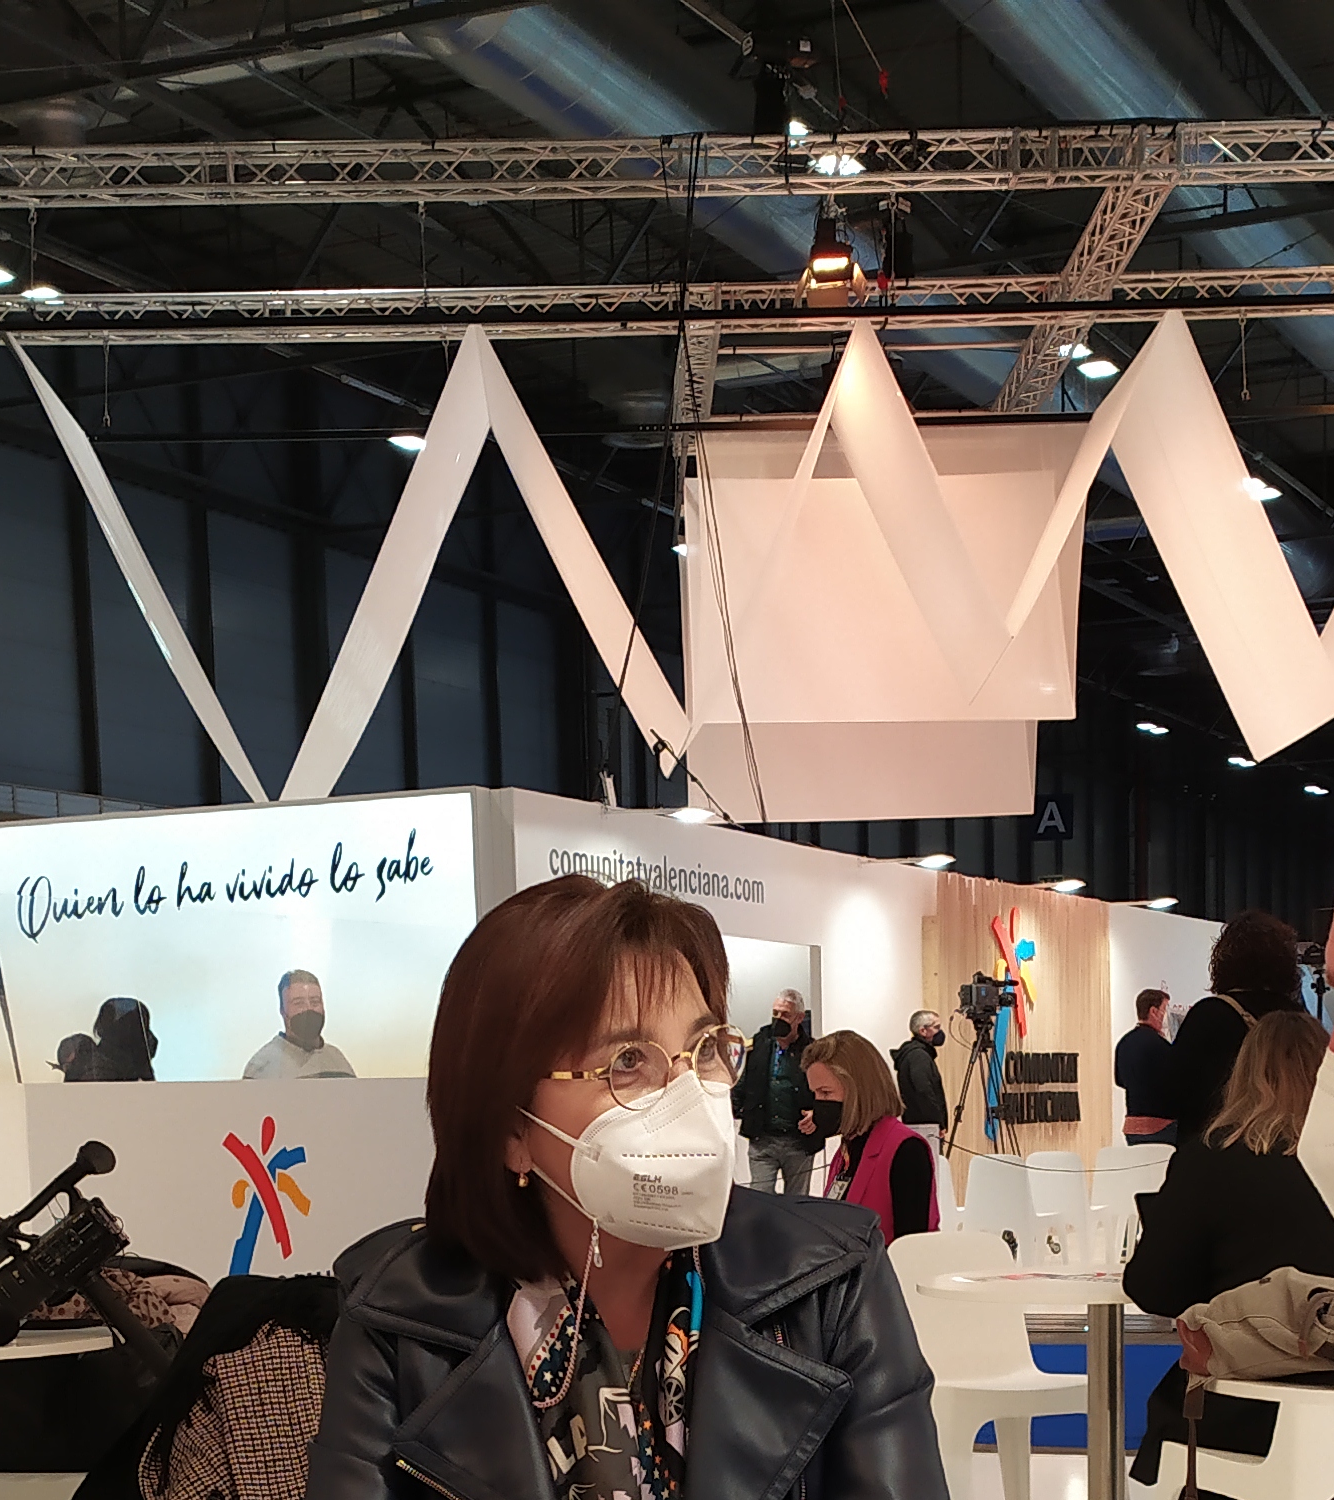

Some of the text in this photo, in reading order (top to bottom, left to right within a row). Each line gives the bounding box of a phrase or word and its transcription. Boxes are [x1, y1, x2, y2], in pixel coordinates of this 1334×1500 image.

[1037, 801, 1066, 834] A
[16, 828, 434, 943] Quien lo ha vivido lo sabe
[547, 1414, 587, 1481] LA
